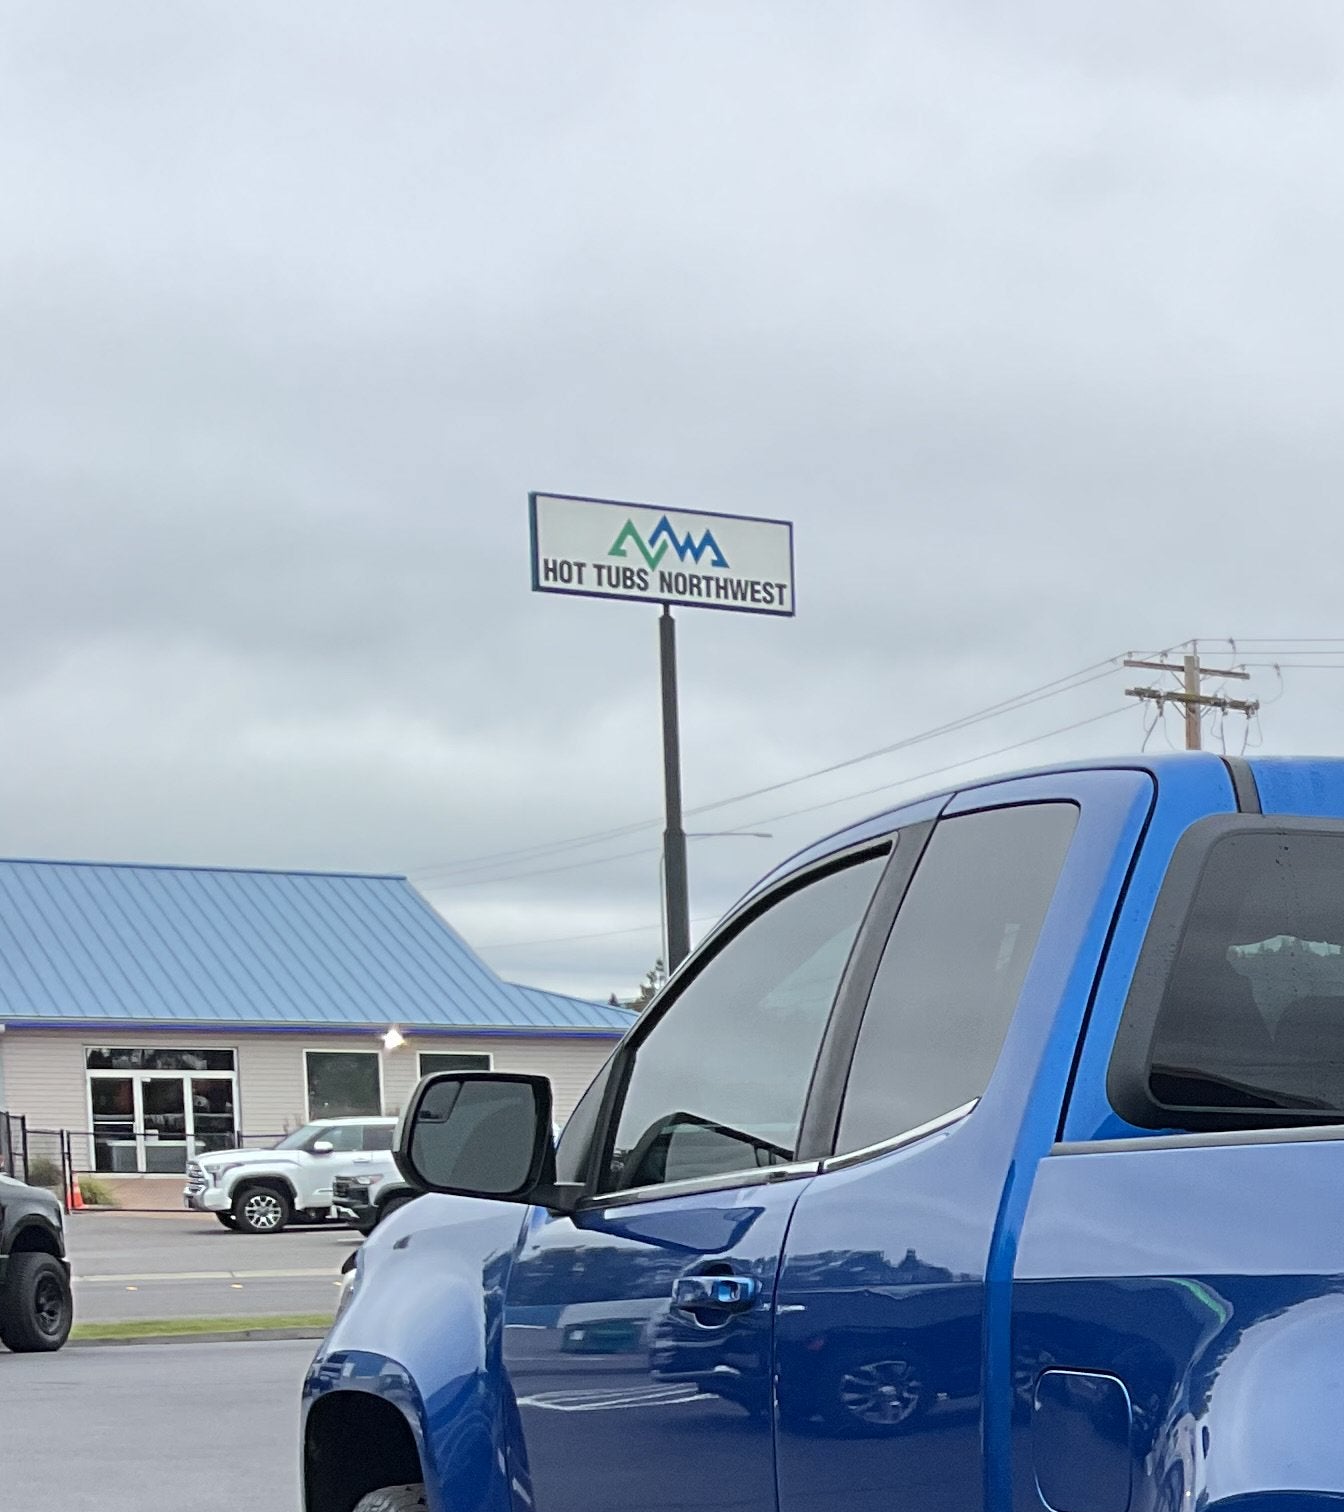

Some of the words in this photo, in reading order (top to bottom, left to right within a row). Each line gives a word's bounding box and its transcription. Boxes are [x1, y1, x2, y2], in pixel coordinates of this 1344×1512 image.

[543, 558, 587, 585] HOT
[592, 563, 649, 592] TUBS
[659, 571, 788, 606] NORTHWEST
